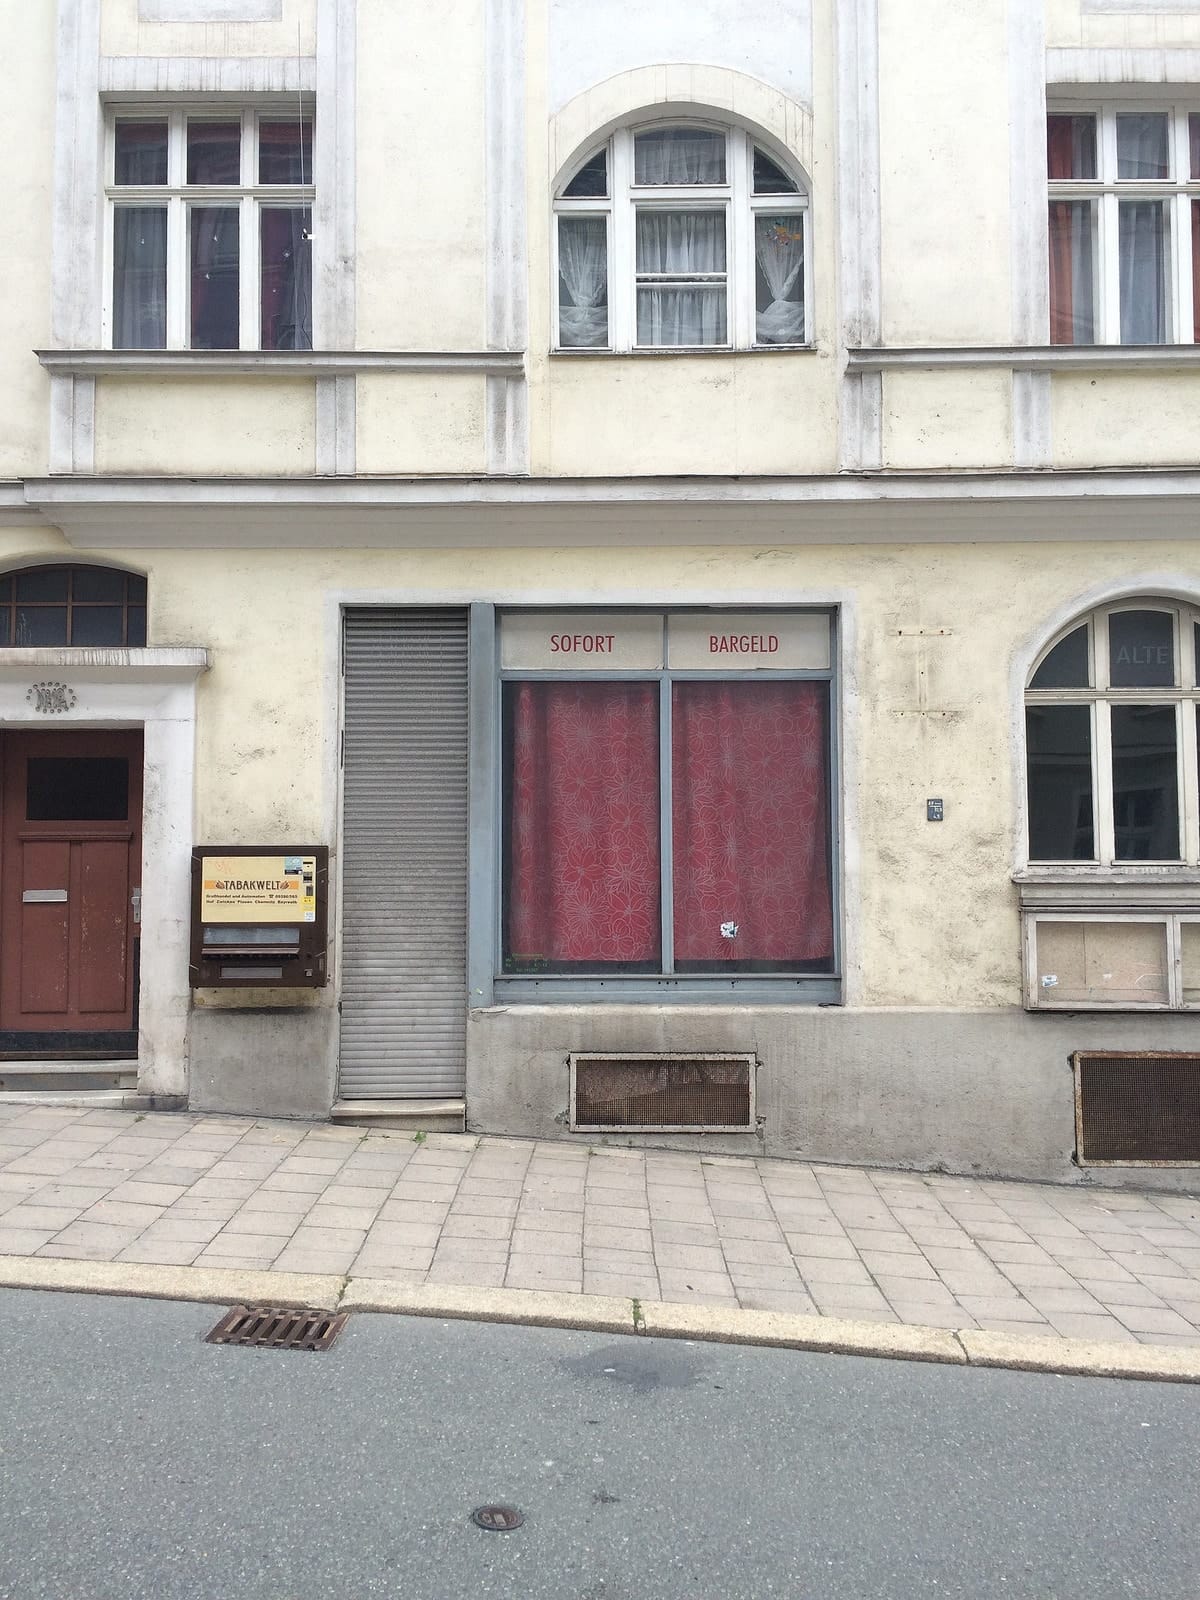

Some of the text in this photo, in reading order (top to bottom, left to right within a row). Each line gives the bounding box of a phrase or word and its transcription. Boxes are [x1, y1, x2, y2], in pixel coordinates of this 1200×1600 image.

[550, 634, 779, 653] SOFORT BARGELD
[1116, 645, 1168, 664] ALTE
[224, 880, 281, 890] TABAKWELT
